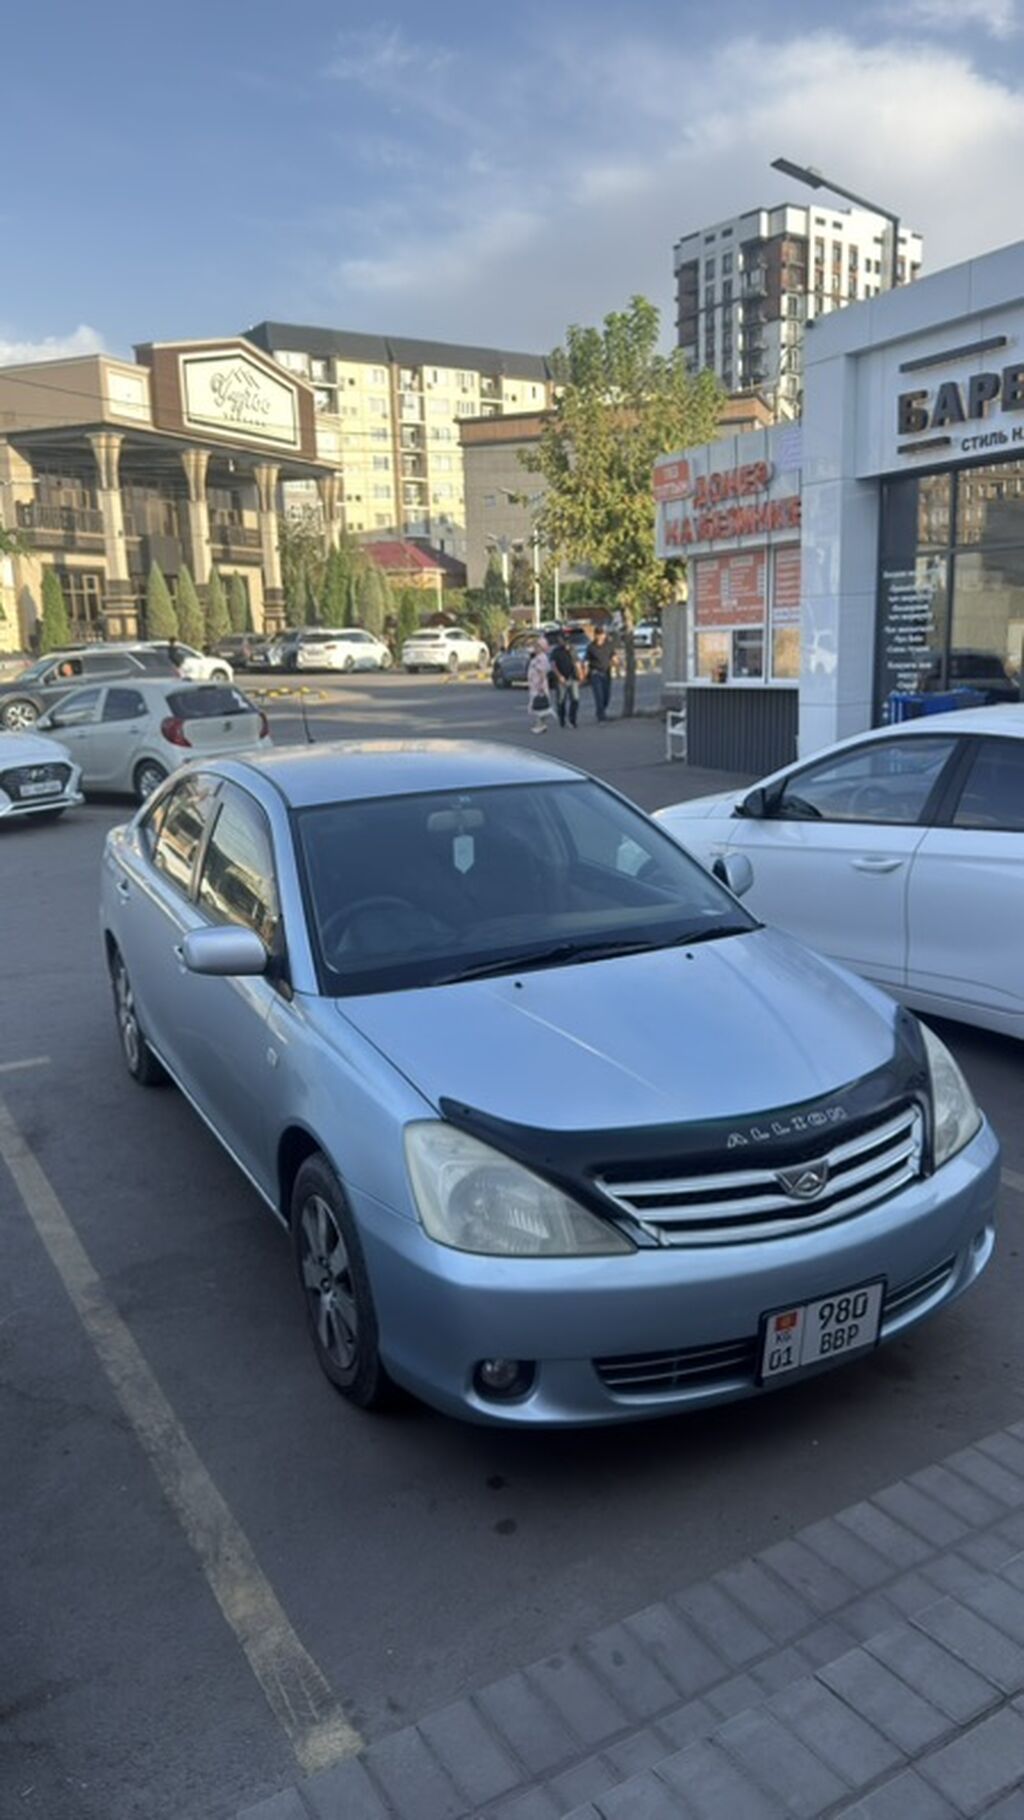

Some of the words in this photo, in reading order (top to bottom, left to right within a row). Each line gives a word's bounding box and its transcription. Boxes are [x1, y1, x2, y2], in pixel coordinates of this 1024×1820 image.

[961, 431, 1009, 452] СТИЛЬ
[693, 461, 771, 510] ДОНЕР
[664, 517, 694, 545] НА
[727, 1106, 846, 1149] ALLION
[818, 1292, 868, 1330] 980
[769, 1346, 793, 1371] 01
